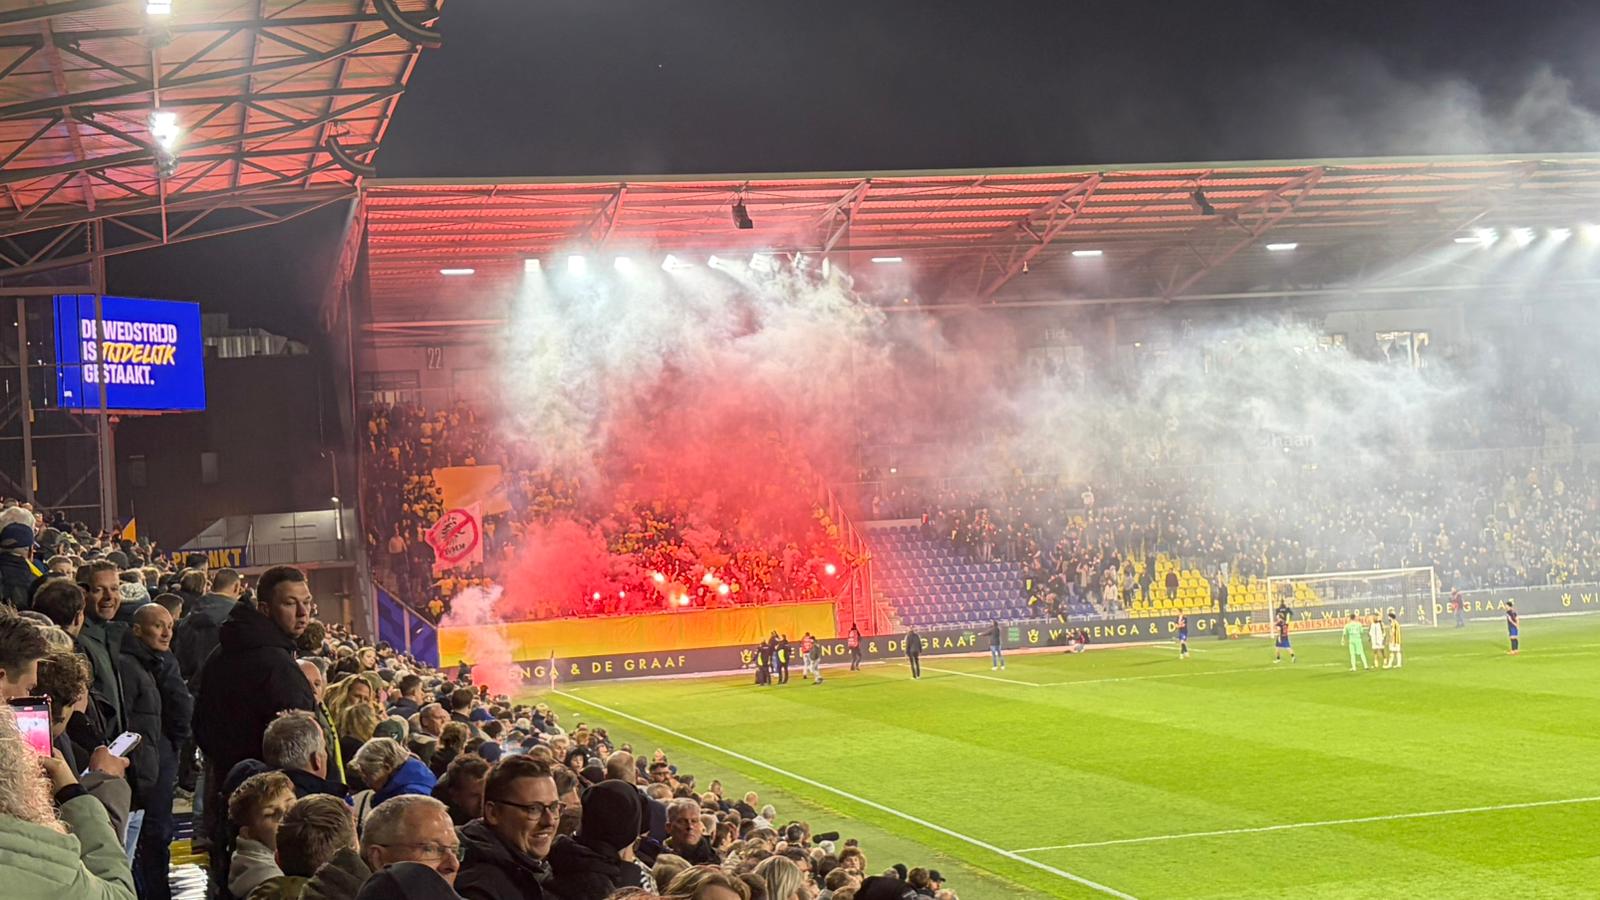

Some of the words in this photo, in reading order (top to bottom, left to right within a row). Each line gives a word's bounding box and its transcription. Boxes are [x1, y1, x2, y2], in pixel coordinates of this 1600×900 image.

[102, 319, 178, 343] WEDSTRIJD
[82, 340, 98, 361] IS
[102, 341, 177, 366] TIJDELIJK
[427, 347, 442, 369] 22
[83, 363, 155, 386] GESTAAKT.
[1149, 622, 1158, 634] &
[868, 641, 878, 653] &
[920, 635, 977, 650] GRAAF
[570, 663, 581, 675] &
[591, 660, 613, 673] DE
[623, 655, 686, 671] GRAAF
